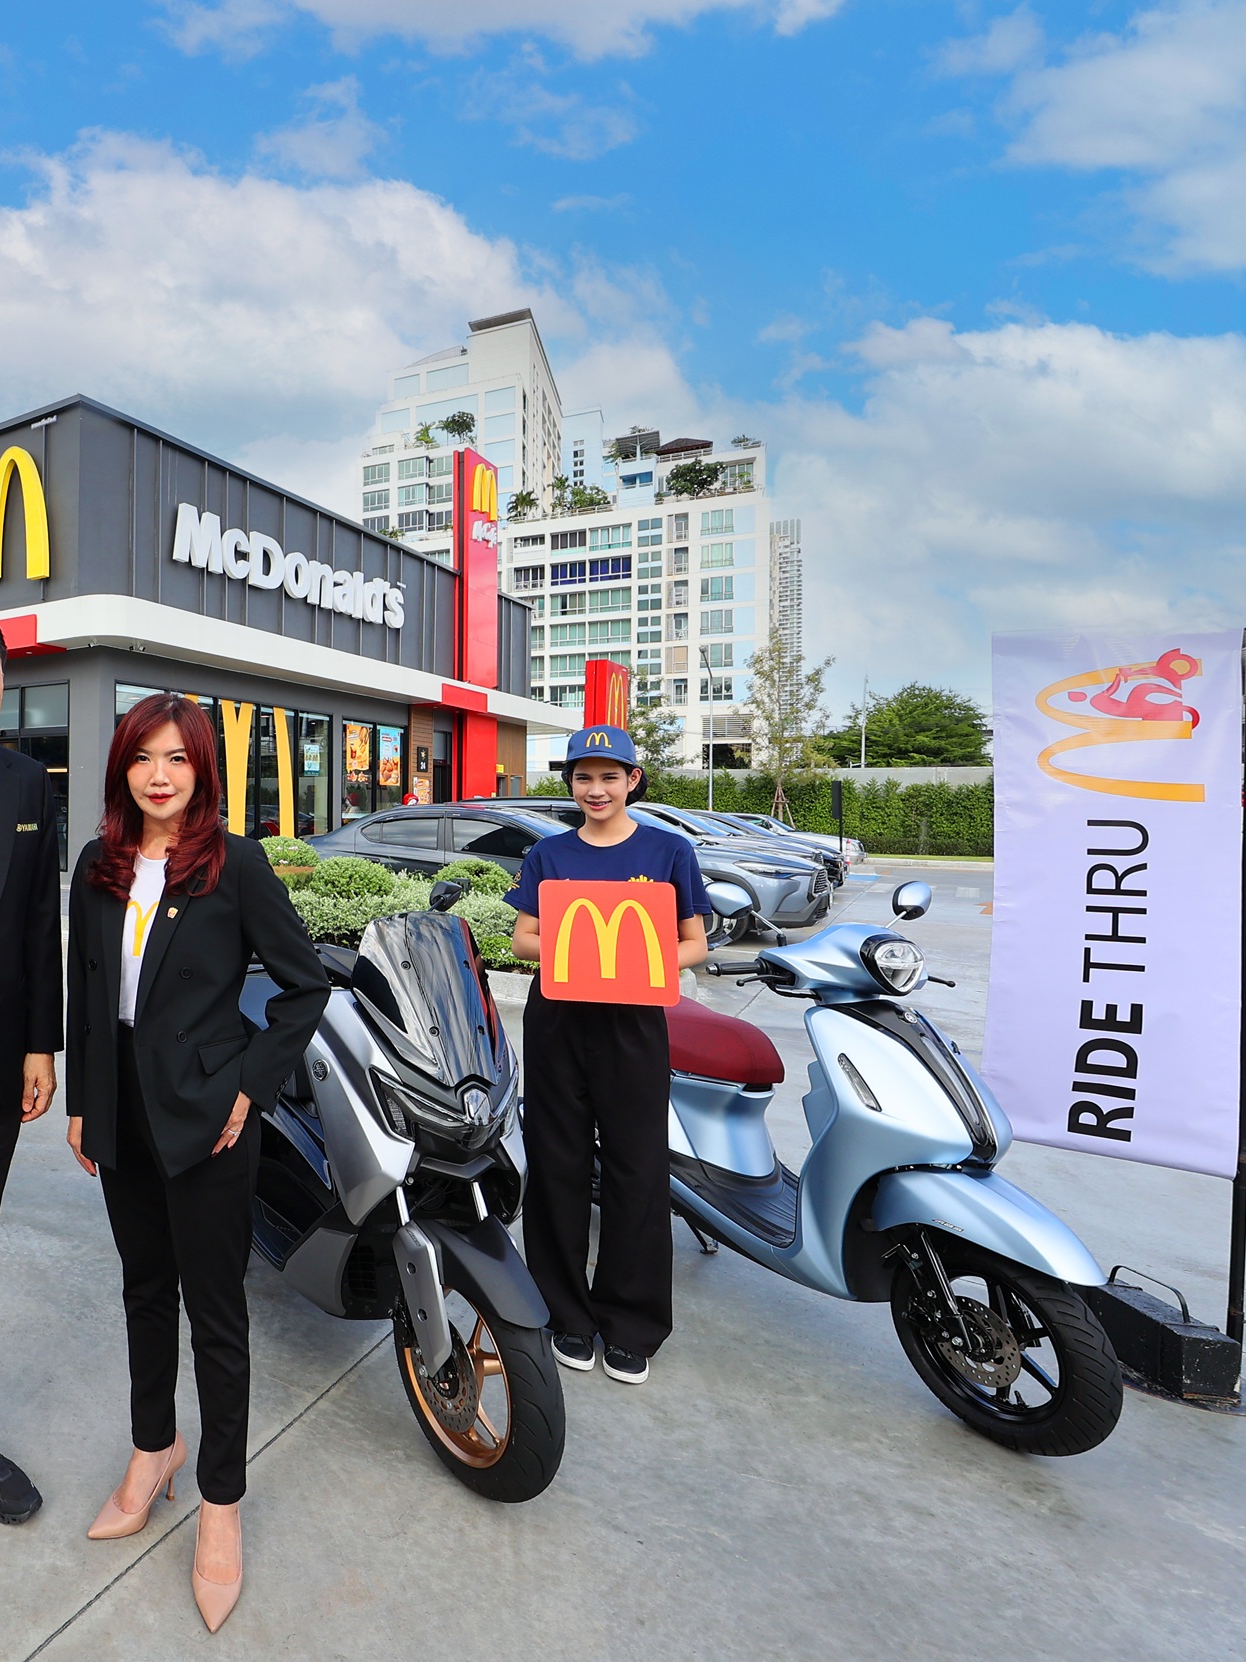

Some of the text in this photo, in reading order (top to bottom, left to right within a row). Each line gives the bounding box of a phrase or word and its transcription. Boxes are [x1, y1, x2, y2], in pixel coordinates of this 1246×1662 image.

[172, 502, 406, 629] McDonald's
[1067, 817, 1150, 1143] RIDE THRU
